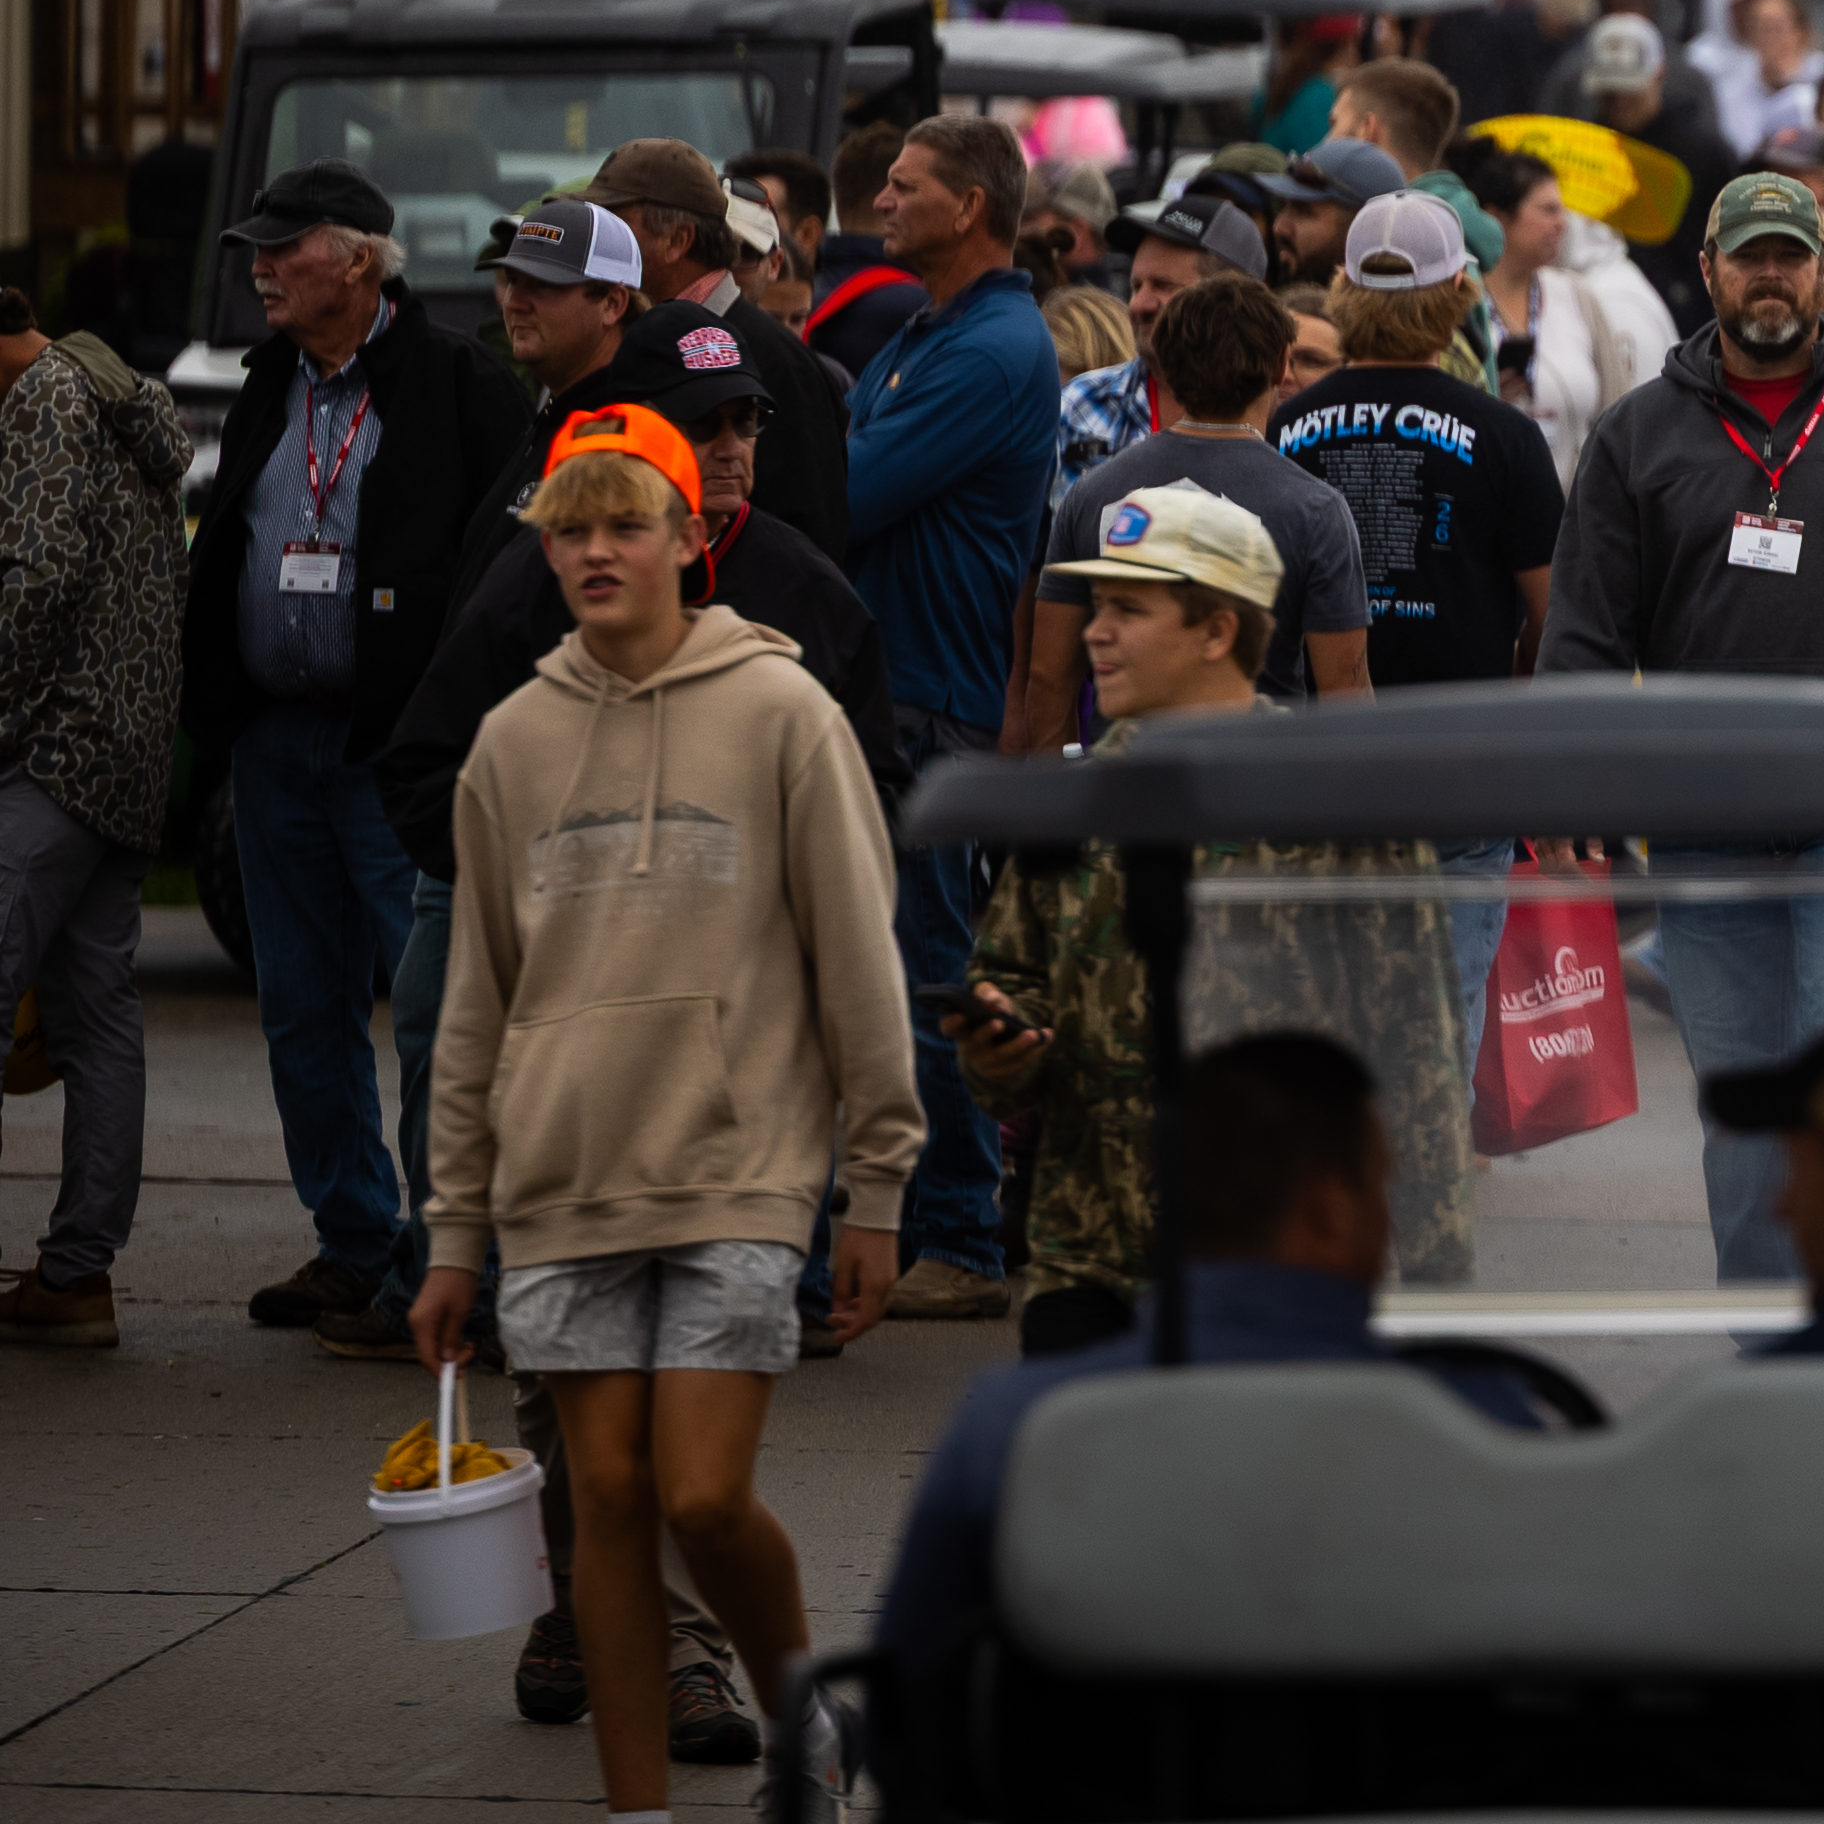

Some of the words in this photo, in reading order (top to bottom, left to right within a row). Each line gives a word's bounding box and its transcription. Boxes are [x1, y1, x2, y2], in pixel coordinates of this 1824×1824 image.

[1279, 403, 1392, 456] MÖTLEY
[1395, 404, 1476, 466] CRÜE
[1369, 599, 1391, 615] OF
[1395, 600, 1435, 619] SINS
